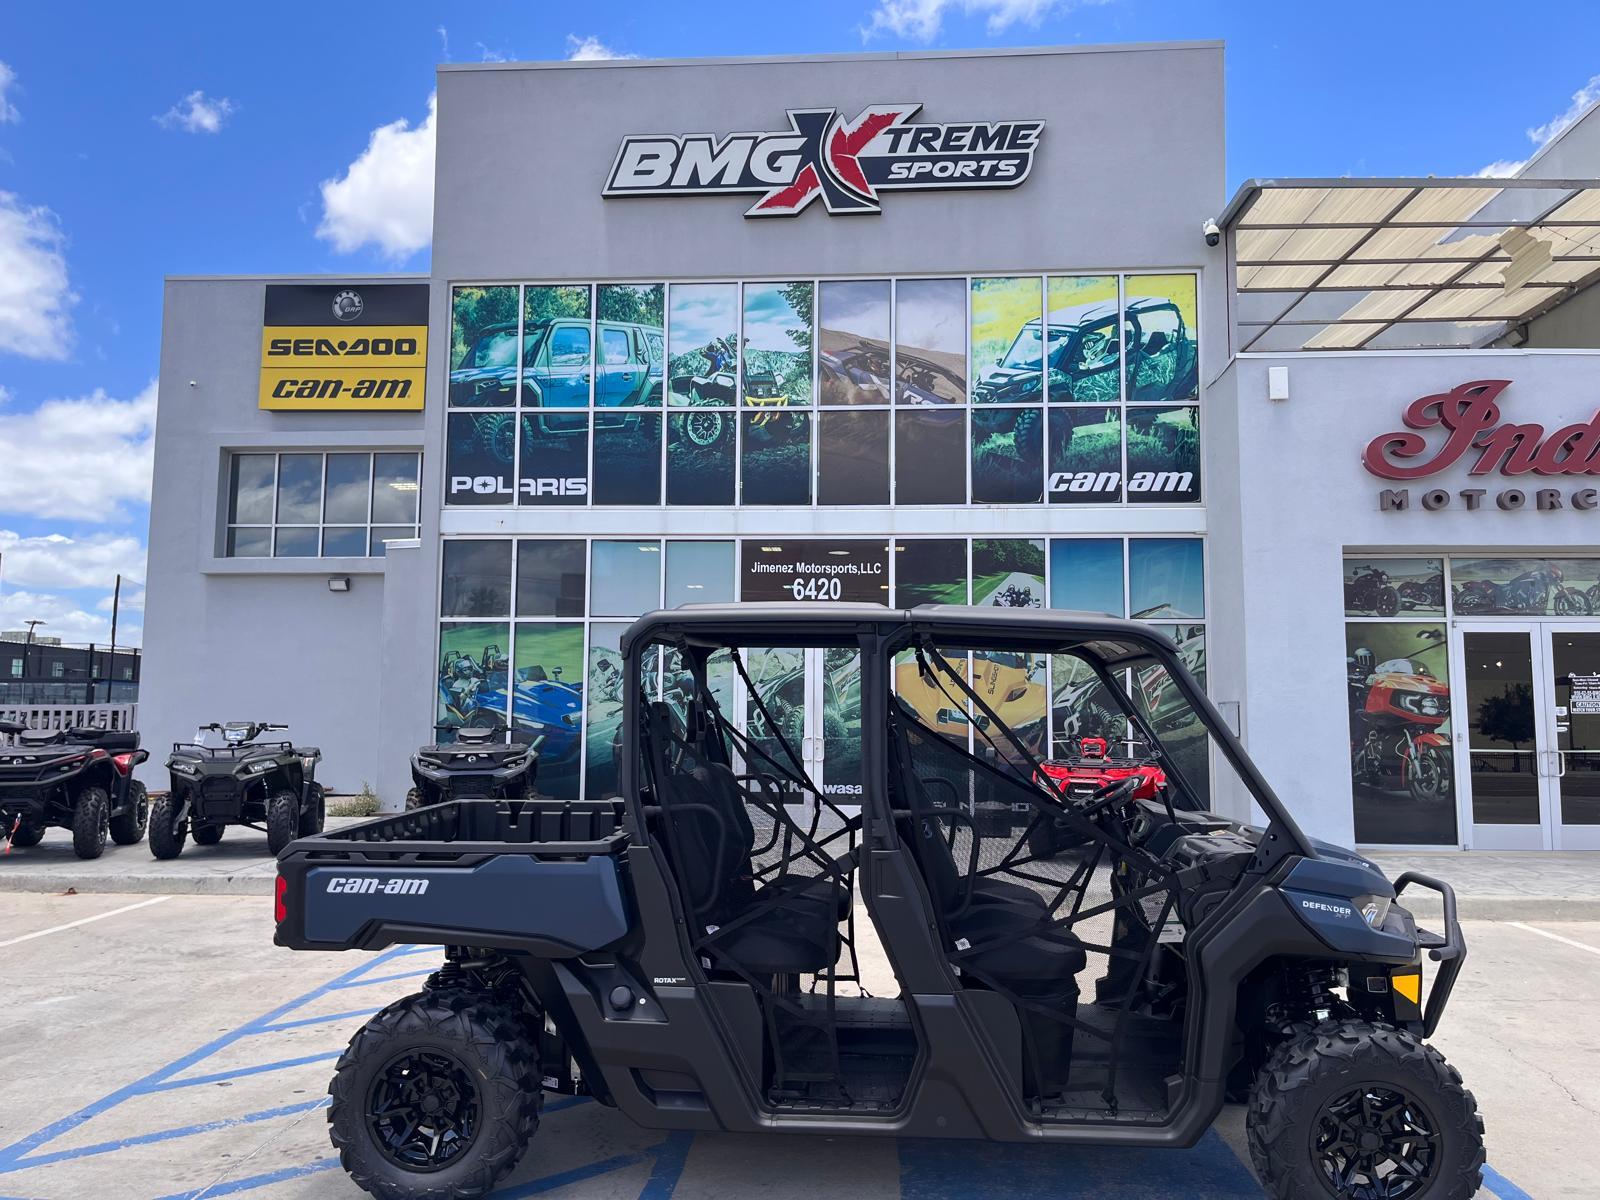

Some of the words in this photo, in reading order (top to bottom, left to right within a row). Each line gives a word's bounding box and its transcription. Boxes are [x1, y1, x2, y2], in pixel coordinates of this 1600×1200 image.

[609, 135, 807, 188] BMG
[887, 159, 1021, 180] SPORTS
[272, 379, 413, 399] can-am
[451, 476, 588, 496] POLARIS
[751, 562, 794, 573] Jimenez
[796, 562, 882, 576] Motorsports,LLC
[792, 577, 842, 601] 6420
[326, 878, 430, 894] can-am
[1302, 900, 1351, 915] DEFENDER
